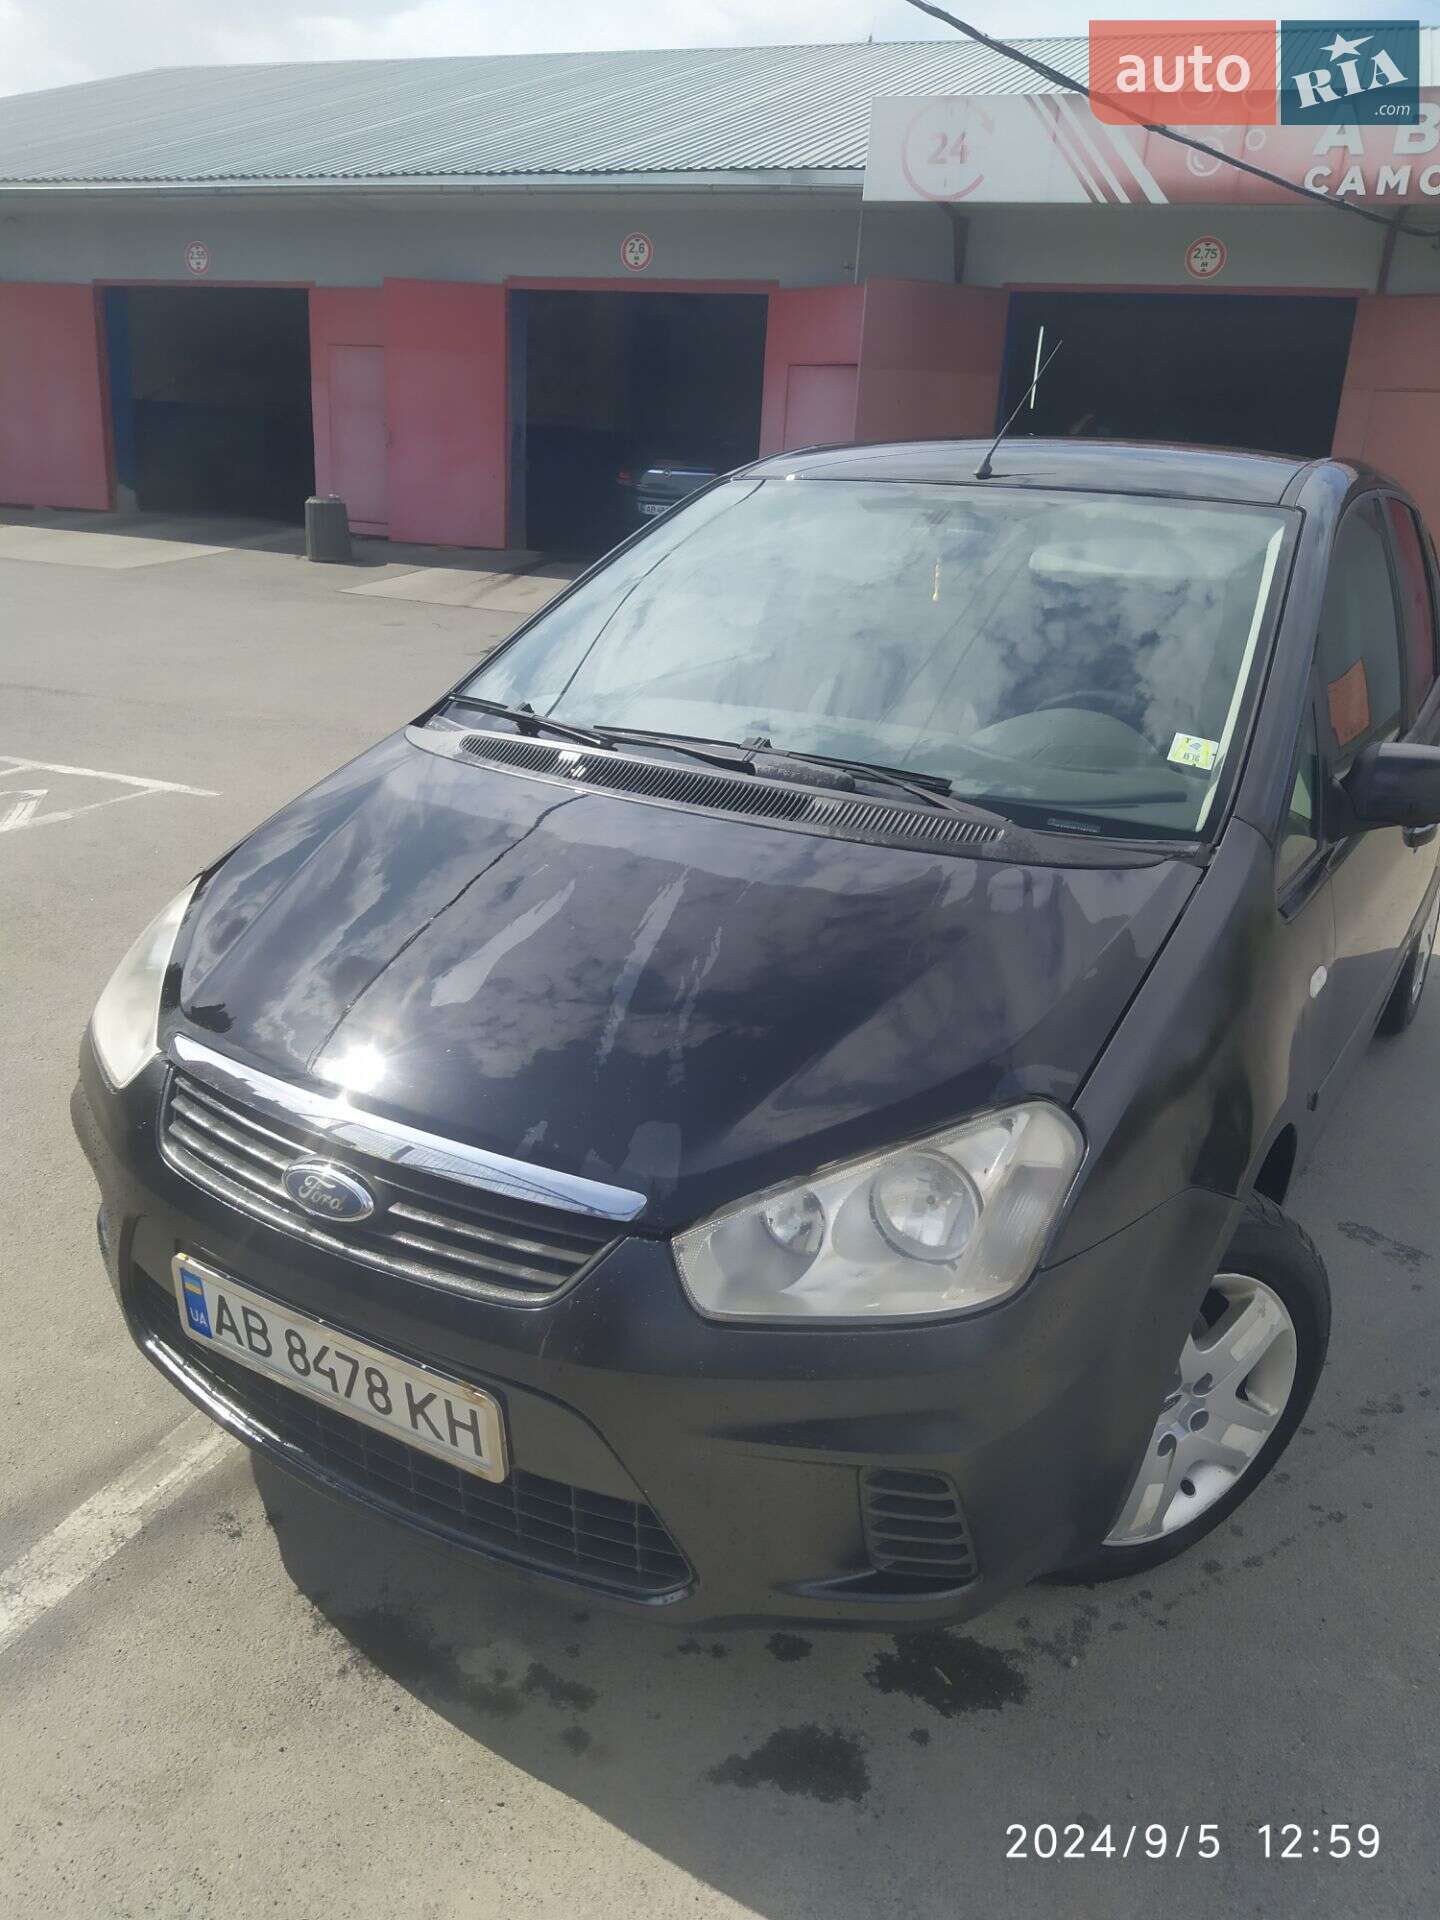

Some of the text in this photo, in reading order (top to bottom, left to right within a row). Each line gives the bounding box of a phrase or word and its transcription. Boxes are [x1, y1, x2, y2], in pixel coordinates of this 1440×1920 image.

[926, 131, 968, 165] 24
[298, 1175, 347, 1211] Ford
[190, 1306, 207, 1327] UA
[216, 1295, 483, 1457] AB 8478 KH
